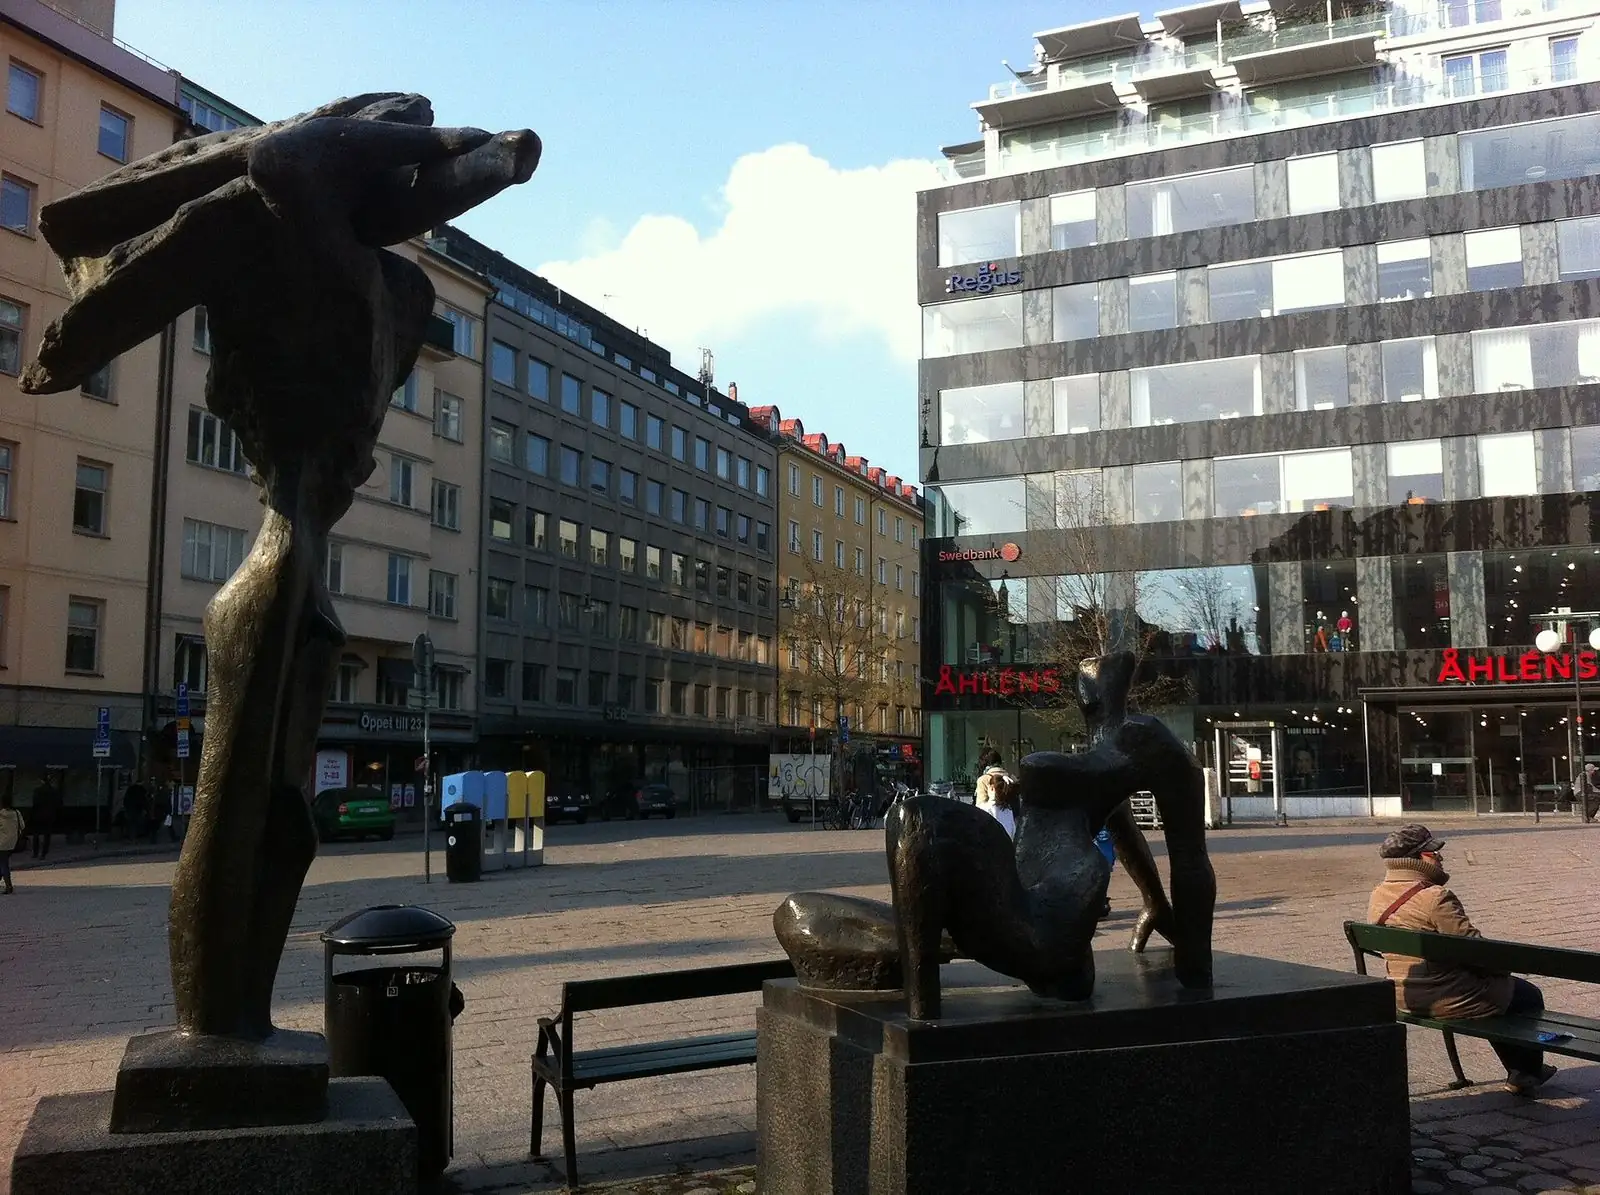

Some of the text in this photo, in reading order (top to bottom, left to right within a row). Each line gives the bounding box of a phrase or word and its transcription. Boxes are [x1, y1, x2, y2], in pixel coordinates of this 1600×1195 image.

[939, 549, 1000, 561] Swedbank
[1437, 648, 1598, 682] ÅHLÉNS
[361, 711, 422, 731] Öppet till 23
